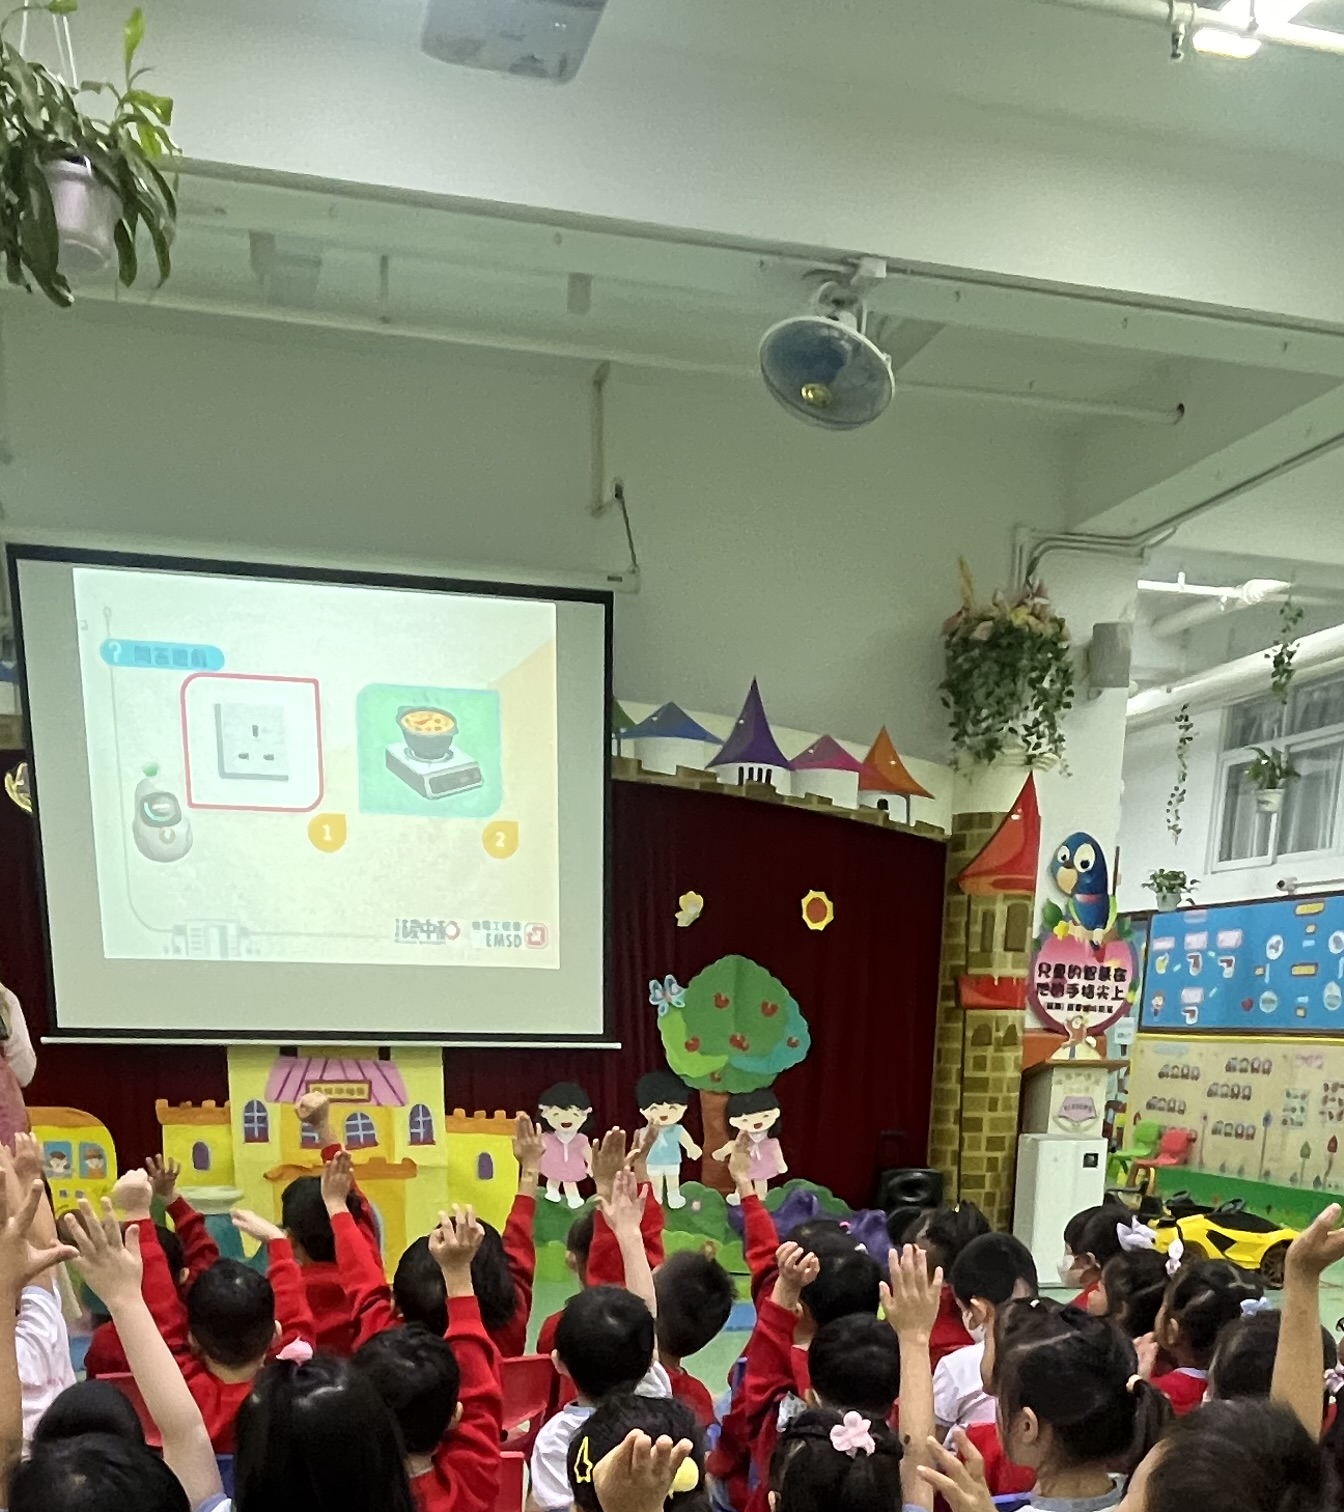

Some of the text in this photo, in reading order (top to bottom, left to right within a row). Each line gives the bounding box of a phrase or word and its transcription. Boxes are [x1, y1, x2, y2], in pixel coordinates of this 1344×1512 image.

[322, 824, 332, 841] 1
[495, 831, 505, 848] 2
[486, 933, 522, 948] EMSD
